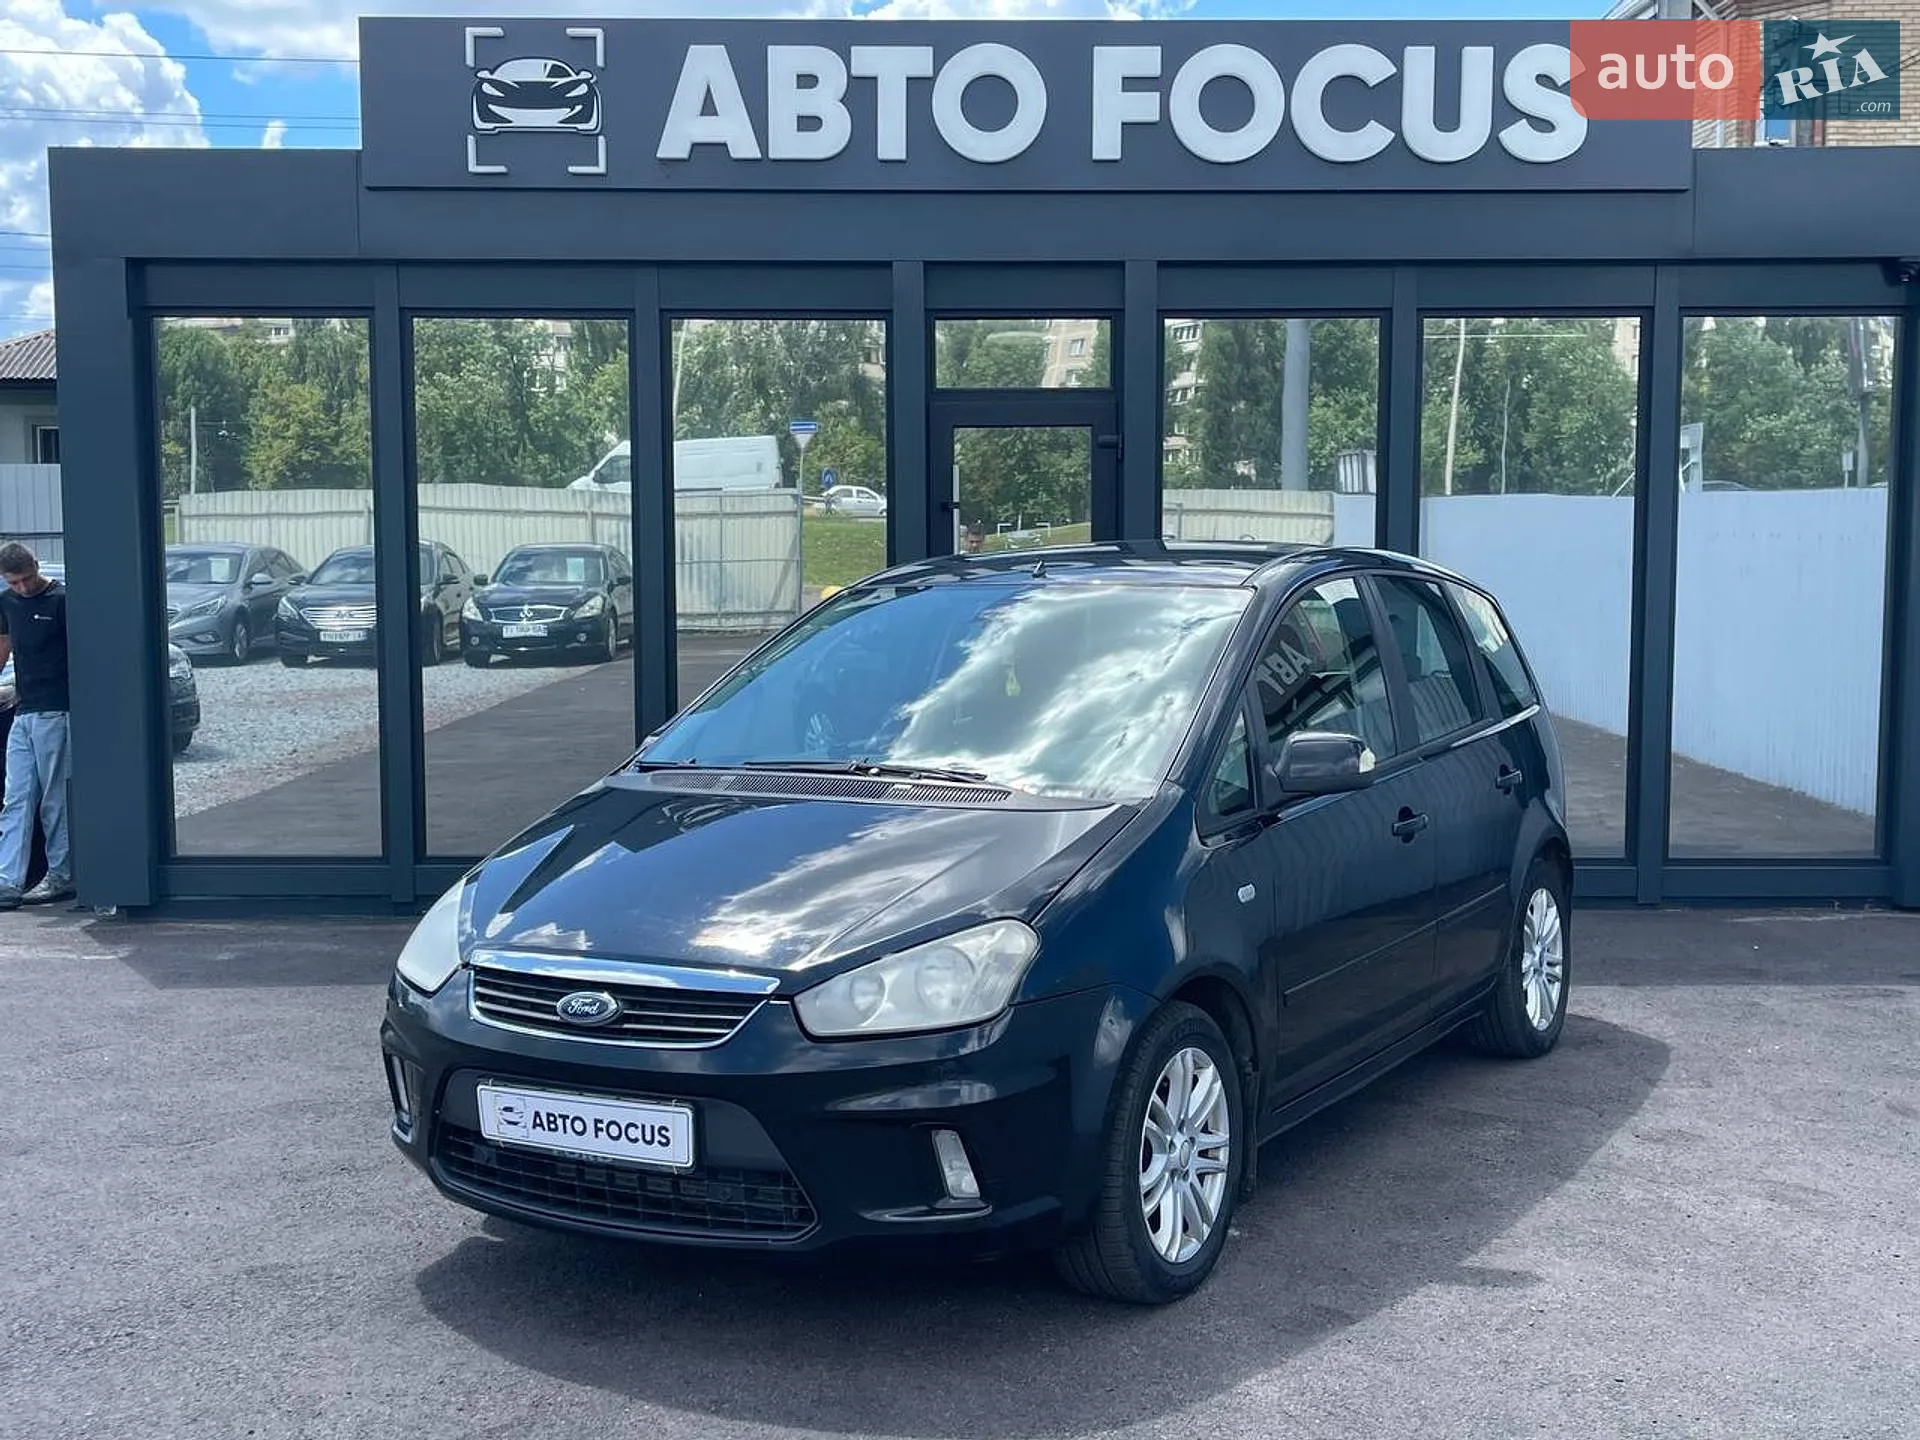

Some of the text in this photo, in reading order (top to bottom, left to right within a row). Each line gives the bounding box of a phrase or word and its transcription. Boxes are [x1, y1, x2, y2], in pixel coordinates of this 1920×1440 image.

[656, 43, 1590, 163] АВТО FOCUS
[568, 998, 601, 1014] Ford
[532, 1111, 671, 1147] АВТО FOCUS
